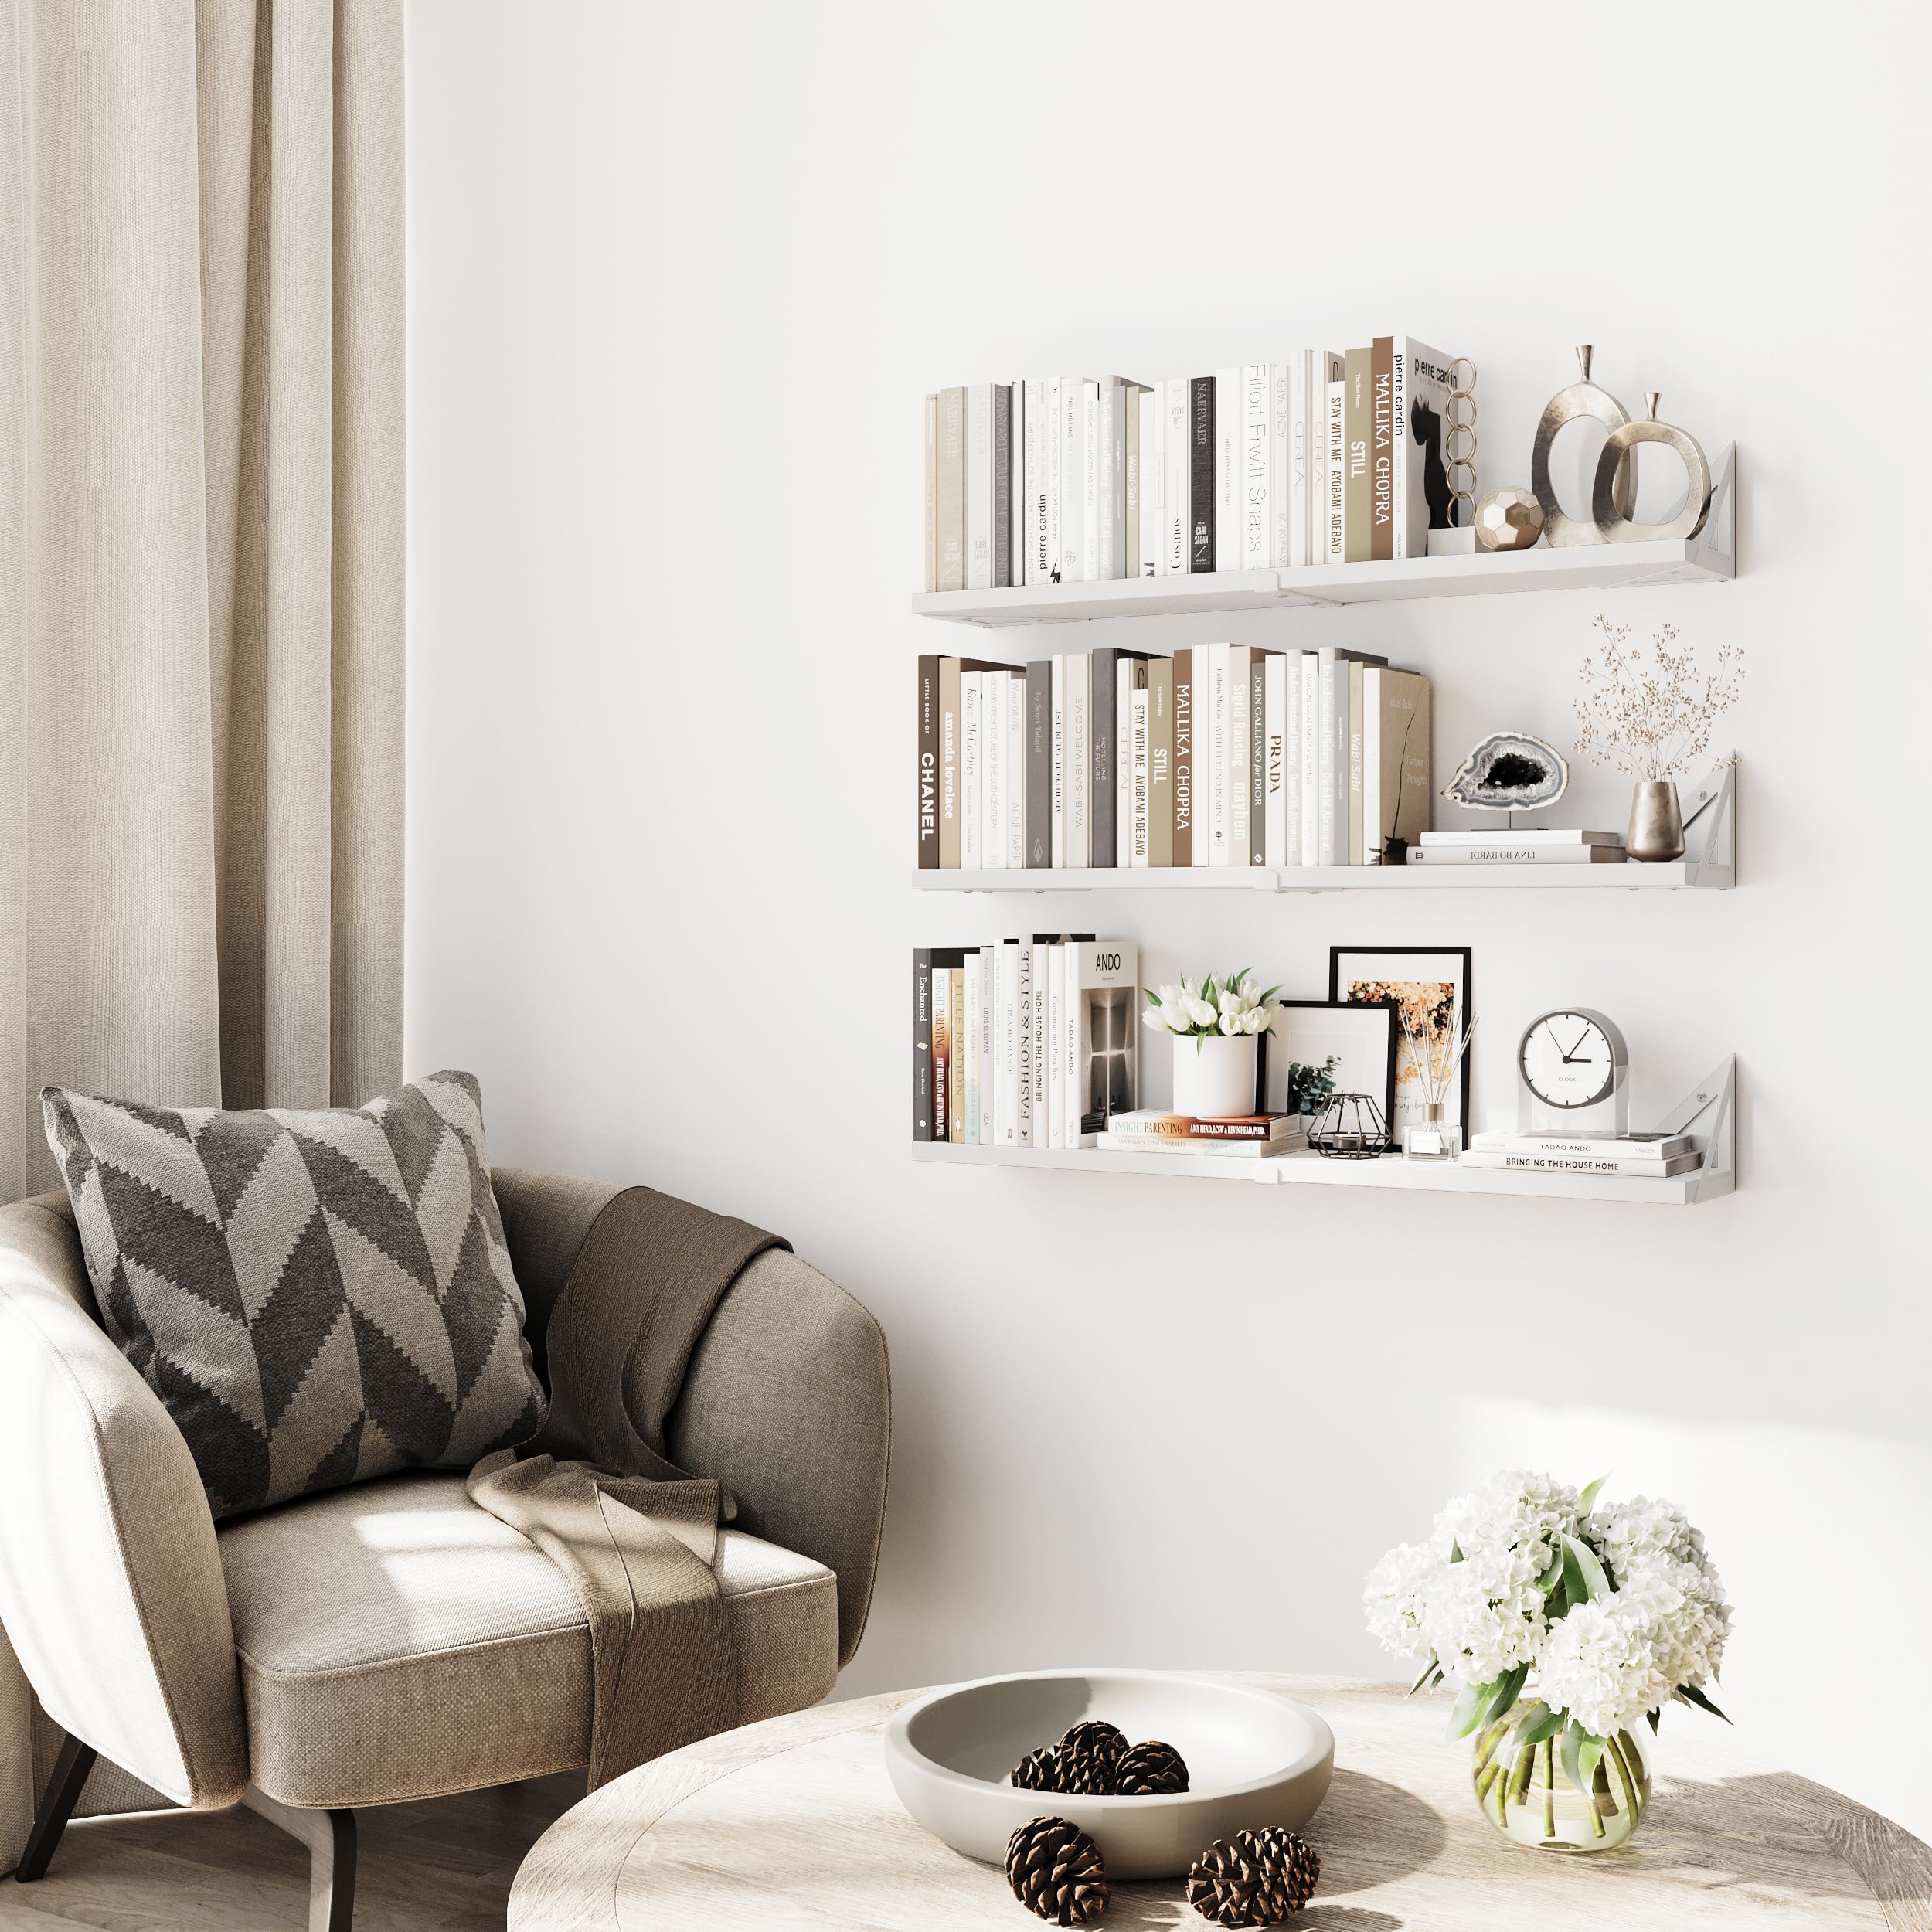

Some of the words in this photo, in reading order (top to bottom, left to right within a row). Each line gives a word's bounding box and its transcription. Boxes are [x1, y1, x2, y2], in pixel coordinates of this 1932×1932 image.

[1393, 355, 1404, 393] pierre
[1414, 355, 1435, 379] pierre
[1437, 368, 1458, 388] carin
[1249, 365, 1266, 417] Elliott
[1331, 397, 1341, 418] STAY
[1197, 383, 1206, 446] NAERVAER
[1376, 373, 1390, 449] MALLIKA
[1393, 396, 1404, 436] cardin
[1331, 422, 1341, 446] WITH
[1249, 424, 1266, 481] Erwitt
[1331, 448, 1341, 462] ME
[1351, 441, 1366, 478] STILL
[1128, 455, 1138, 510] Wabi-Sabi
[1331, 471, 1341, 510] AYOBAMI
[1376, 457, 1390, 526] CHOPRA
[1037, 495, 1048, 531] cardin
[1196, 526, 1207, 535] CARL
[1249, 487, 1266, 552] Snaps
[1170, 518, 1181, 568] Cosmos
[1194, 536, 1209, 545] SAGAN
[1331, 514, 1341, 554] ADEBAYO
[1037, 535, 1048, 570] pierre
[964, 688, 977, 717] Karen
[1034, 692, 1042, 702] by
[1135, 705, 1145, 725] STAY
[1232, 684, 1246, 717] Sigrid
[924, 725, 930, 735] OF
[945, 712, 956, 763] amanda
[1177, 685, 1190, 757] MALLIKA
[964, 723, 977, 776] McCartney
[1135, 729, 1145, 750] WITH
[1232, 722, 1246, 767] Rausing
[1135, 754, 1145, 767] ME
[1154, 749, 1168, 784] STILL
[1270, 736, 1281, 794] PRADA
[1352, 733, 1361, 791] Wabi-Sabi
[921, 753, 934, 841] CHANEL
[945, 767, 956, 819] lovelace
[1135, 775, 1145, 814] AYOBAMI
[1177, 766, 1190, 830] CHOPRA
[1231, 782, 1248, 840] mayhem
[1135, 817, 1145, 855] ADEBAYO
[1096, 953, 1121, 971] ANDO
[935, 976, 944, 1005] INSIGHT
[935, 1008, 944, 1049] PARENTING
[1021, 1015, 1029, 1029] &
[936, 1056, 944, 1067] AMY
[936, 1068, 944, 1081] HEAD,
[936, 1097, 944, 1111] KEVIN
[936, 1111, 944, 1124] HEAD,
[1115, 1121, 1142, 1132] INSIGHT
[1145, 1122, 1182, 1134] PARENTING
[1190, 1124, 1199, 1133] AMY
[1199, 1124, 1213, 1134] HEAD,
[1228, 1126, 1240, 1134] KEVIN
[1240, 1126, 1253, 1136] HEAD,
[1506, 1158, 1545, 1167] BRINGING
[1548, 1159, 1563, 1168] THE
[1595, 1162, 1618, 1171] HOME
